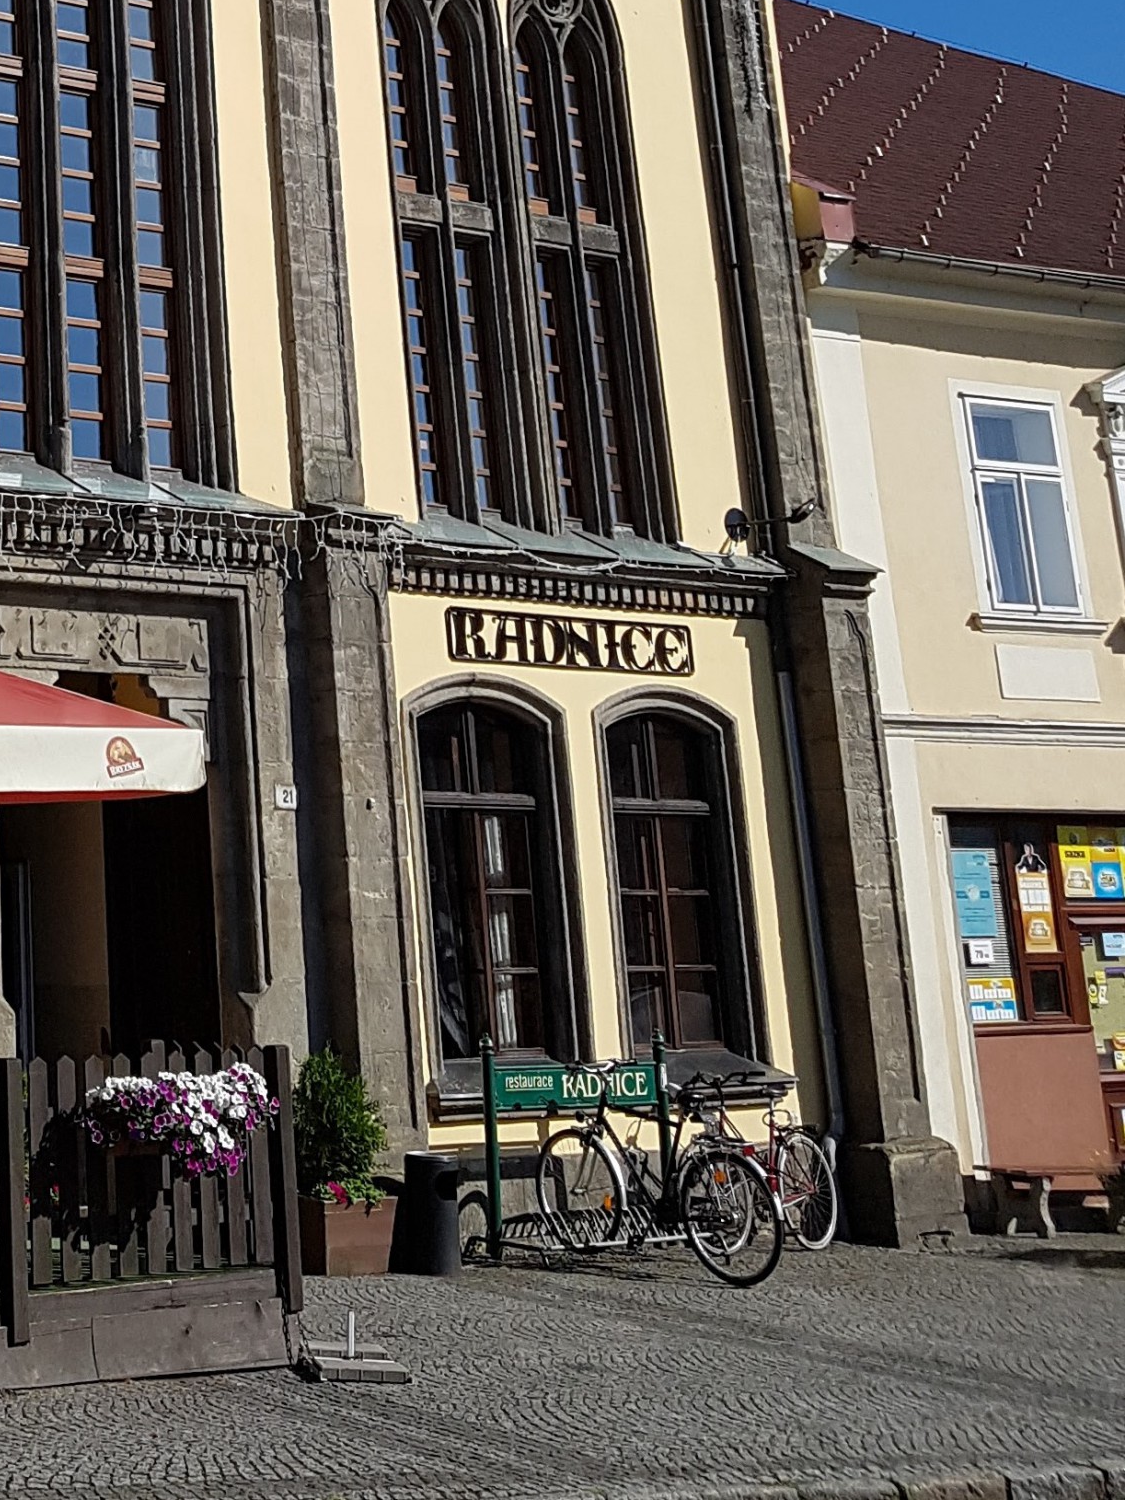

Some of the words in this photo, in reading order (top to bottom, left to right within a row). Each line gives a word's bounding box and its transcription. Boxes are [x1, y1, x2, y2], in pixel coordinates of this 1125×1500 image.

[449, 609, 690, 673] RADNICE
[282, 789, 294, 804] 21
[505, 1074, 554, 1088] restaurace
